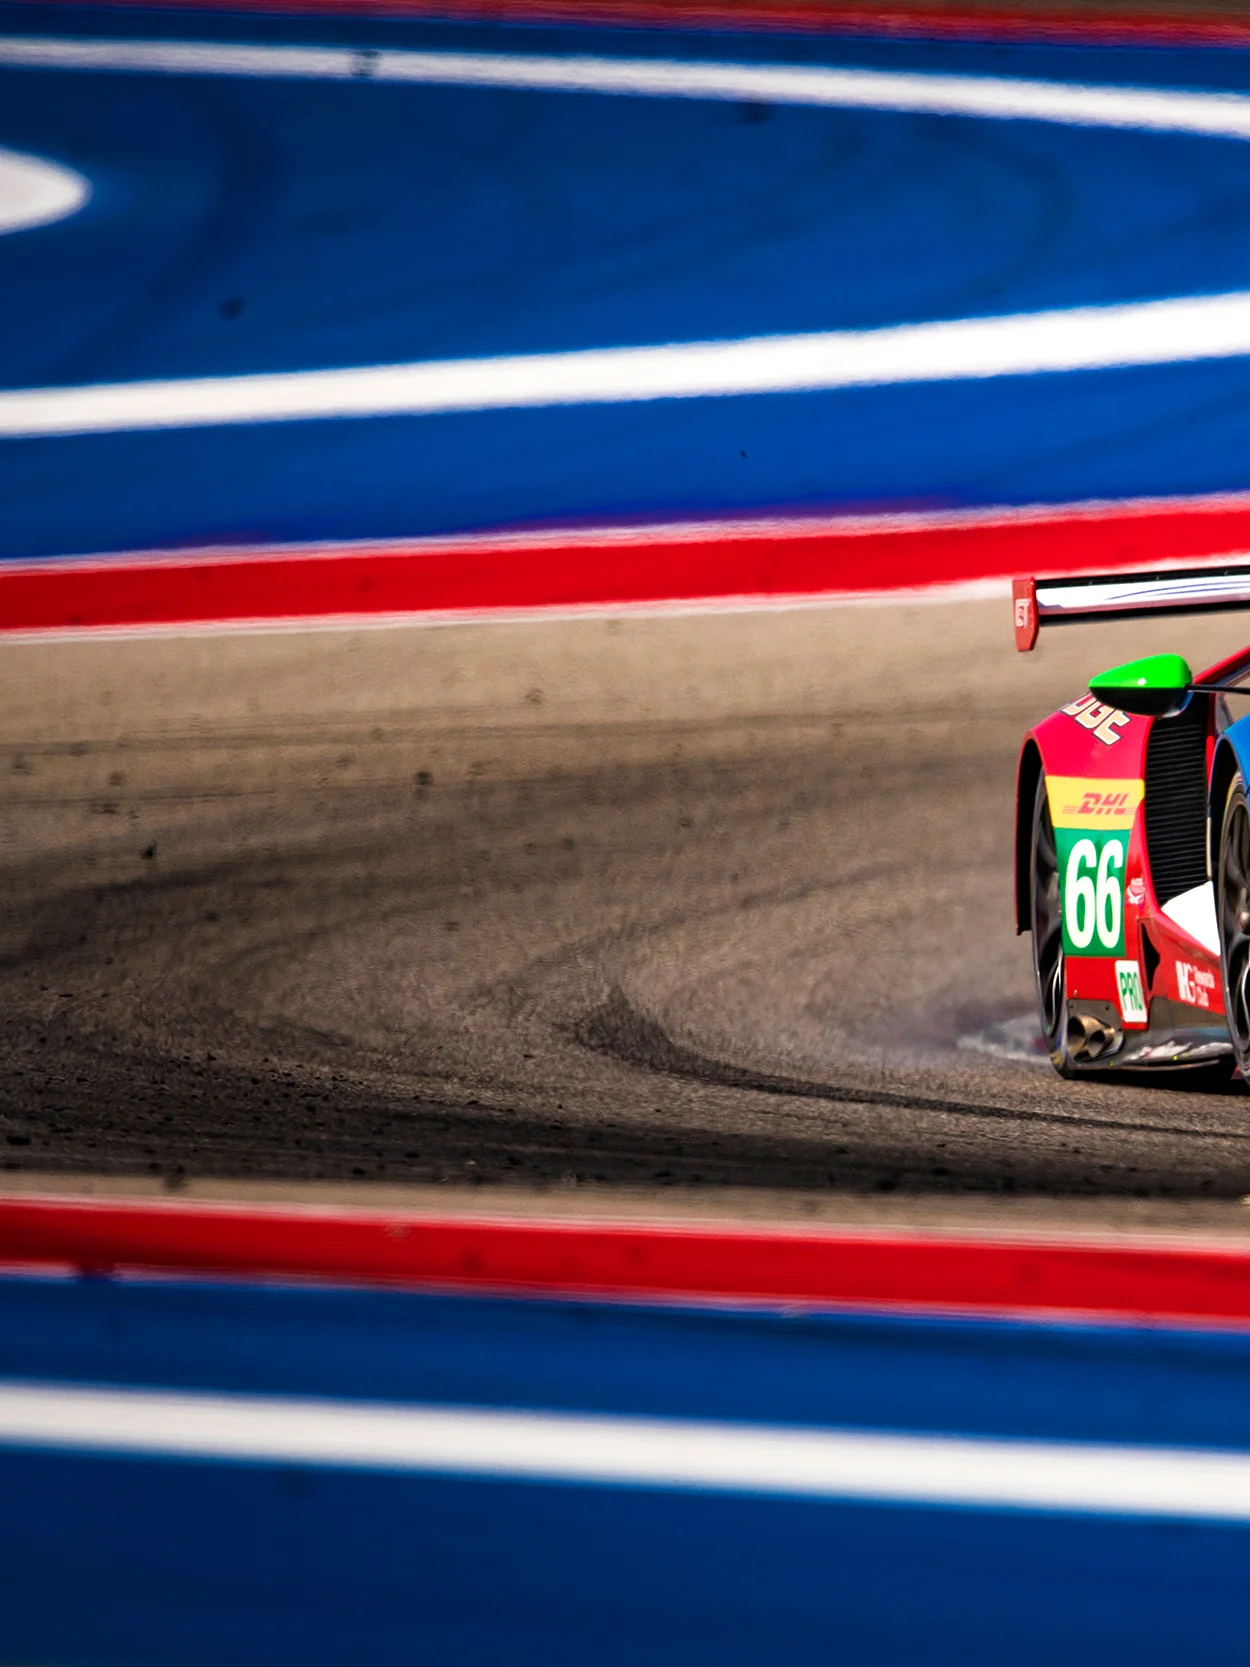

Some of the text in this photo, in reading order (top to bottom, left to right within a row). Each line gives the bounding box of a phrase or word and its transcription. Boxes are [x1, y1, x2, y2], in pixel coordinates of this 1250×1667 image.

[1061, 692, 1131, 746] DGE
[1077, 793, 1129, 815] DHL
[1065, 839, 1124, 948] 66
[1119, 971, 1144, 1011] PRO
